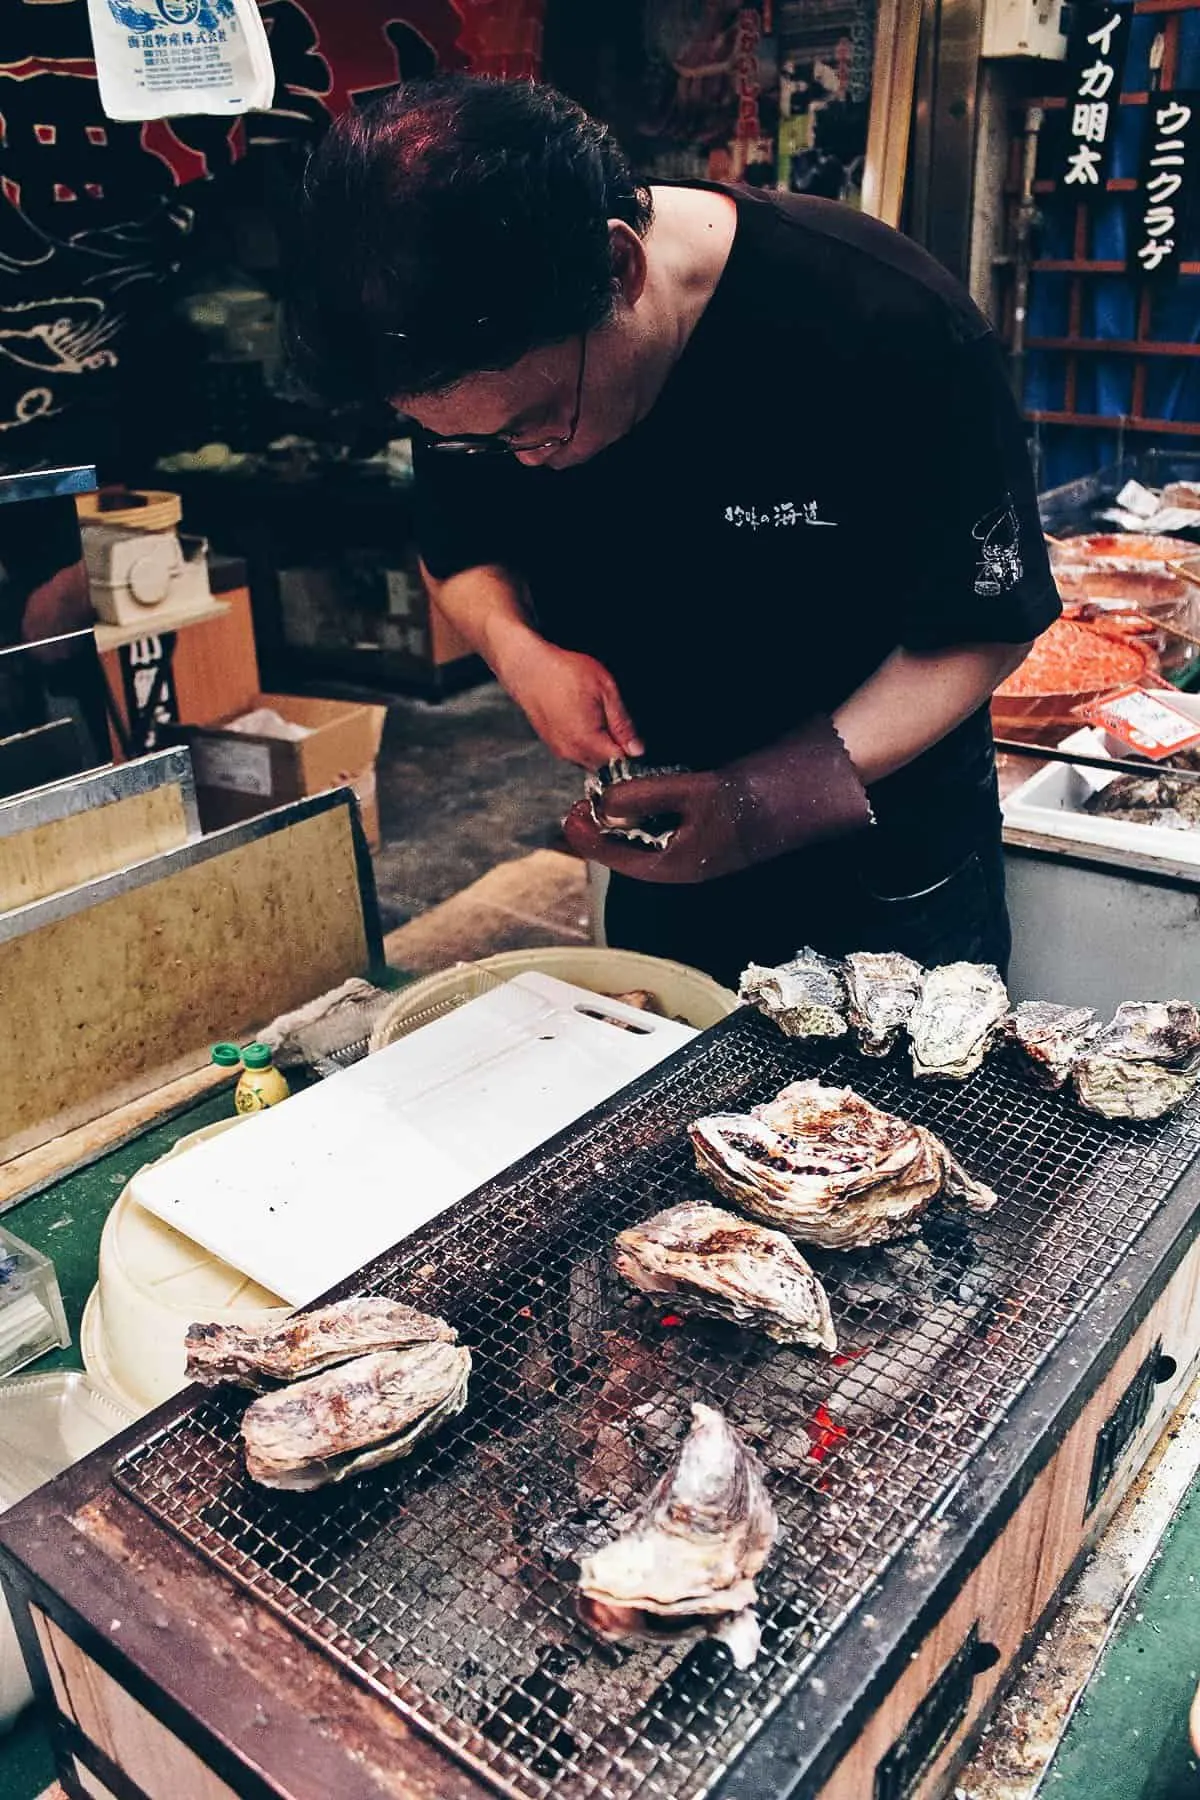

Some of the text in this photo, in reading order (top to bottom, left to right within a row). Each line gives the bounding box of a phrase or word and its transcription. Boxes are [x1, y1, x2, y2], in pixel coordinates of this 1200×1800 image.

[1063, 13, 1122, 185] イカ明太
[1138, 101, 1191, 271] ウニクラゲ
